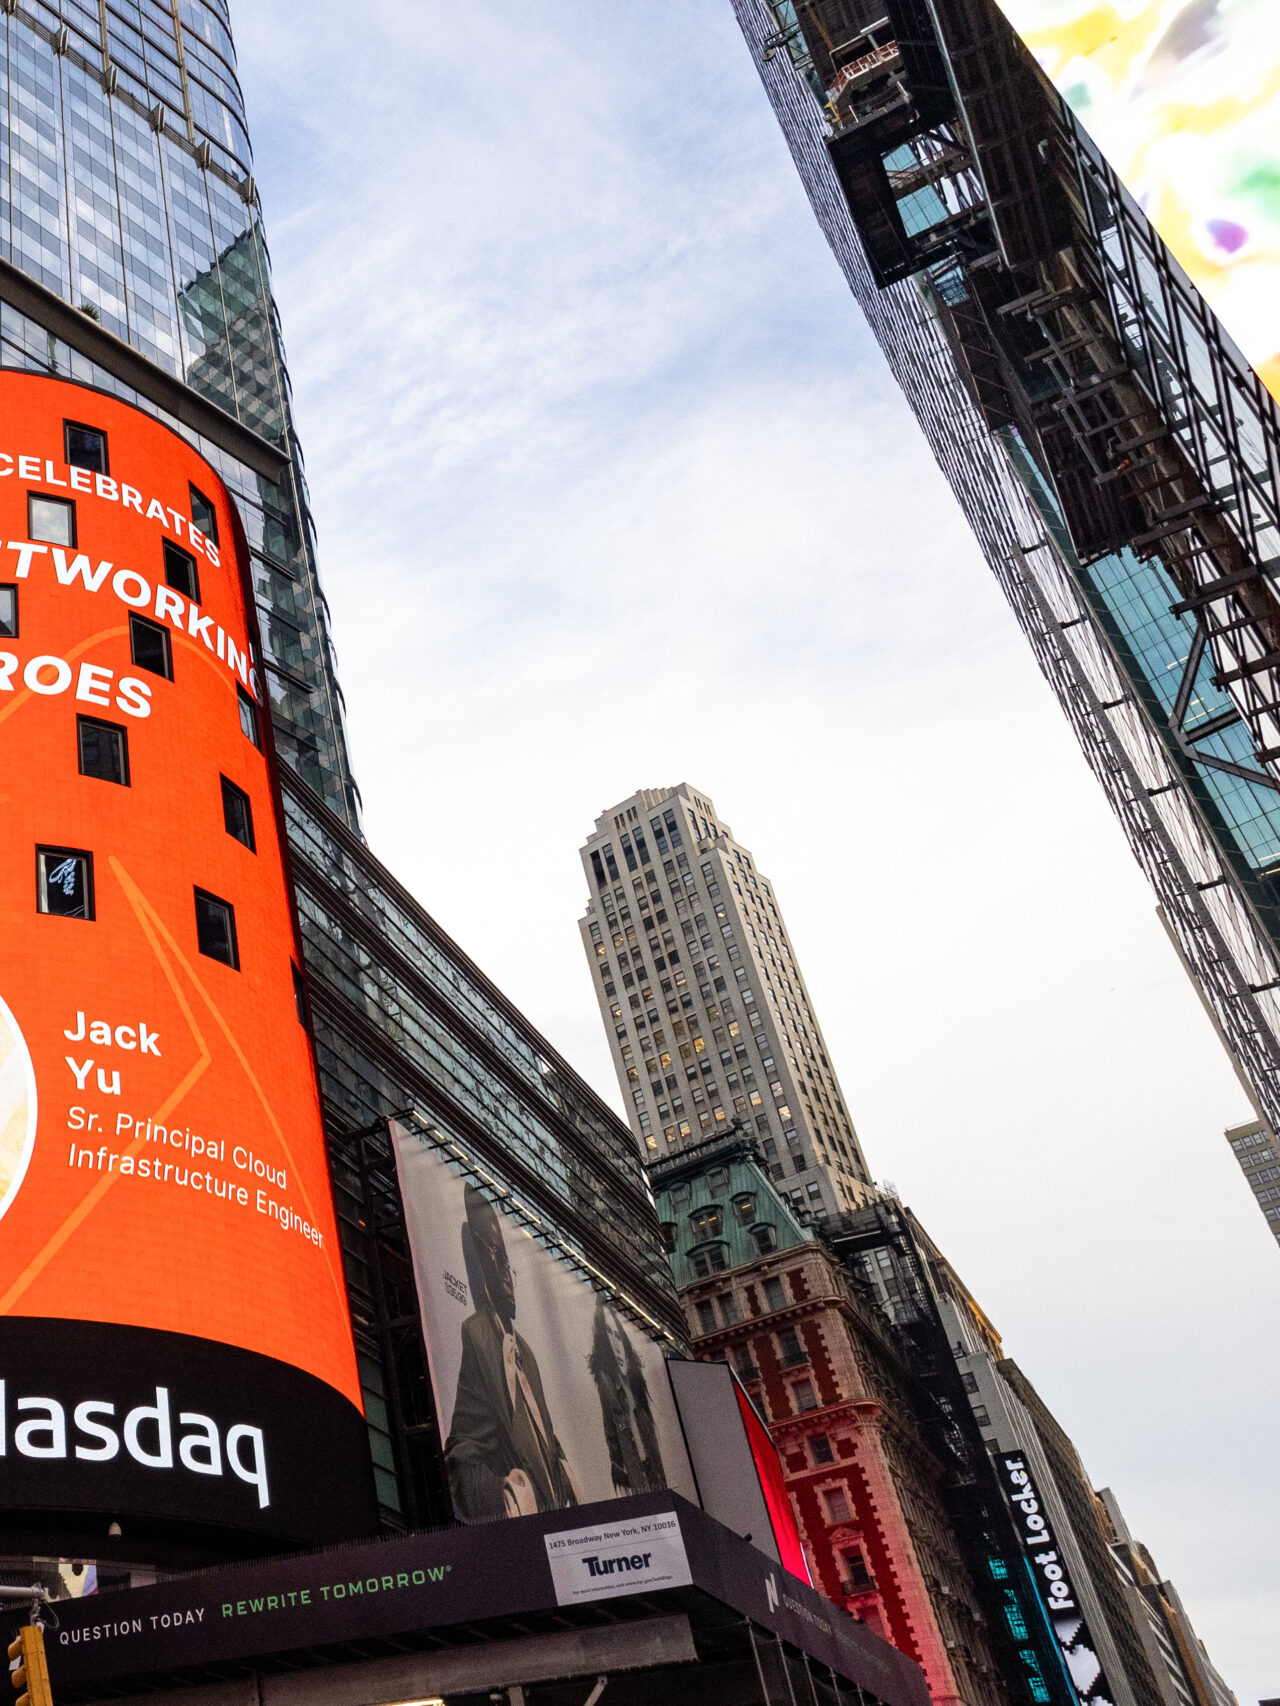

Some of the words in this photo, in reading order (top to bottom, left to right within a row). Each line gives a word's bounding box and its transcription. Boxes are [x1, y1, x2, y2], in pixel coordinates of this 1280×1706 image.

[63, 1010, 162, 1057] Jack
[65, 1056, 121, 1095] Yu
[67, 1106, 102, 1133] Sr.
[115, 1112, 225, 1162] Principal
[233, 1146, 287, 1190] Cloud
[69, 1143, 249, 1206] Infrastructure
[256, 1190, 323, 1249] Engineer
[549, 1541, 566, 1550] 1475
[567, 1535, 602, 1547] Broadway
[603, 1531, 620, 1540] New
[621, 1527, 640, 1536] York,
[641, 1524, 651, 1533] NY
[653, 1520, 676, 1531] 10036
[582, 1552, 651, 1576] Turner
[1034, 1550, 1075, 1610] Foot
[59, 1618, 143, 1646] QUESTION
[150, 1607, 206, 1630] TODAY
[221, 1589, 312, 1618] REWRITE
